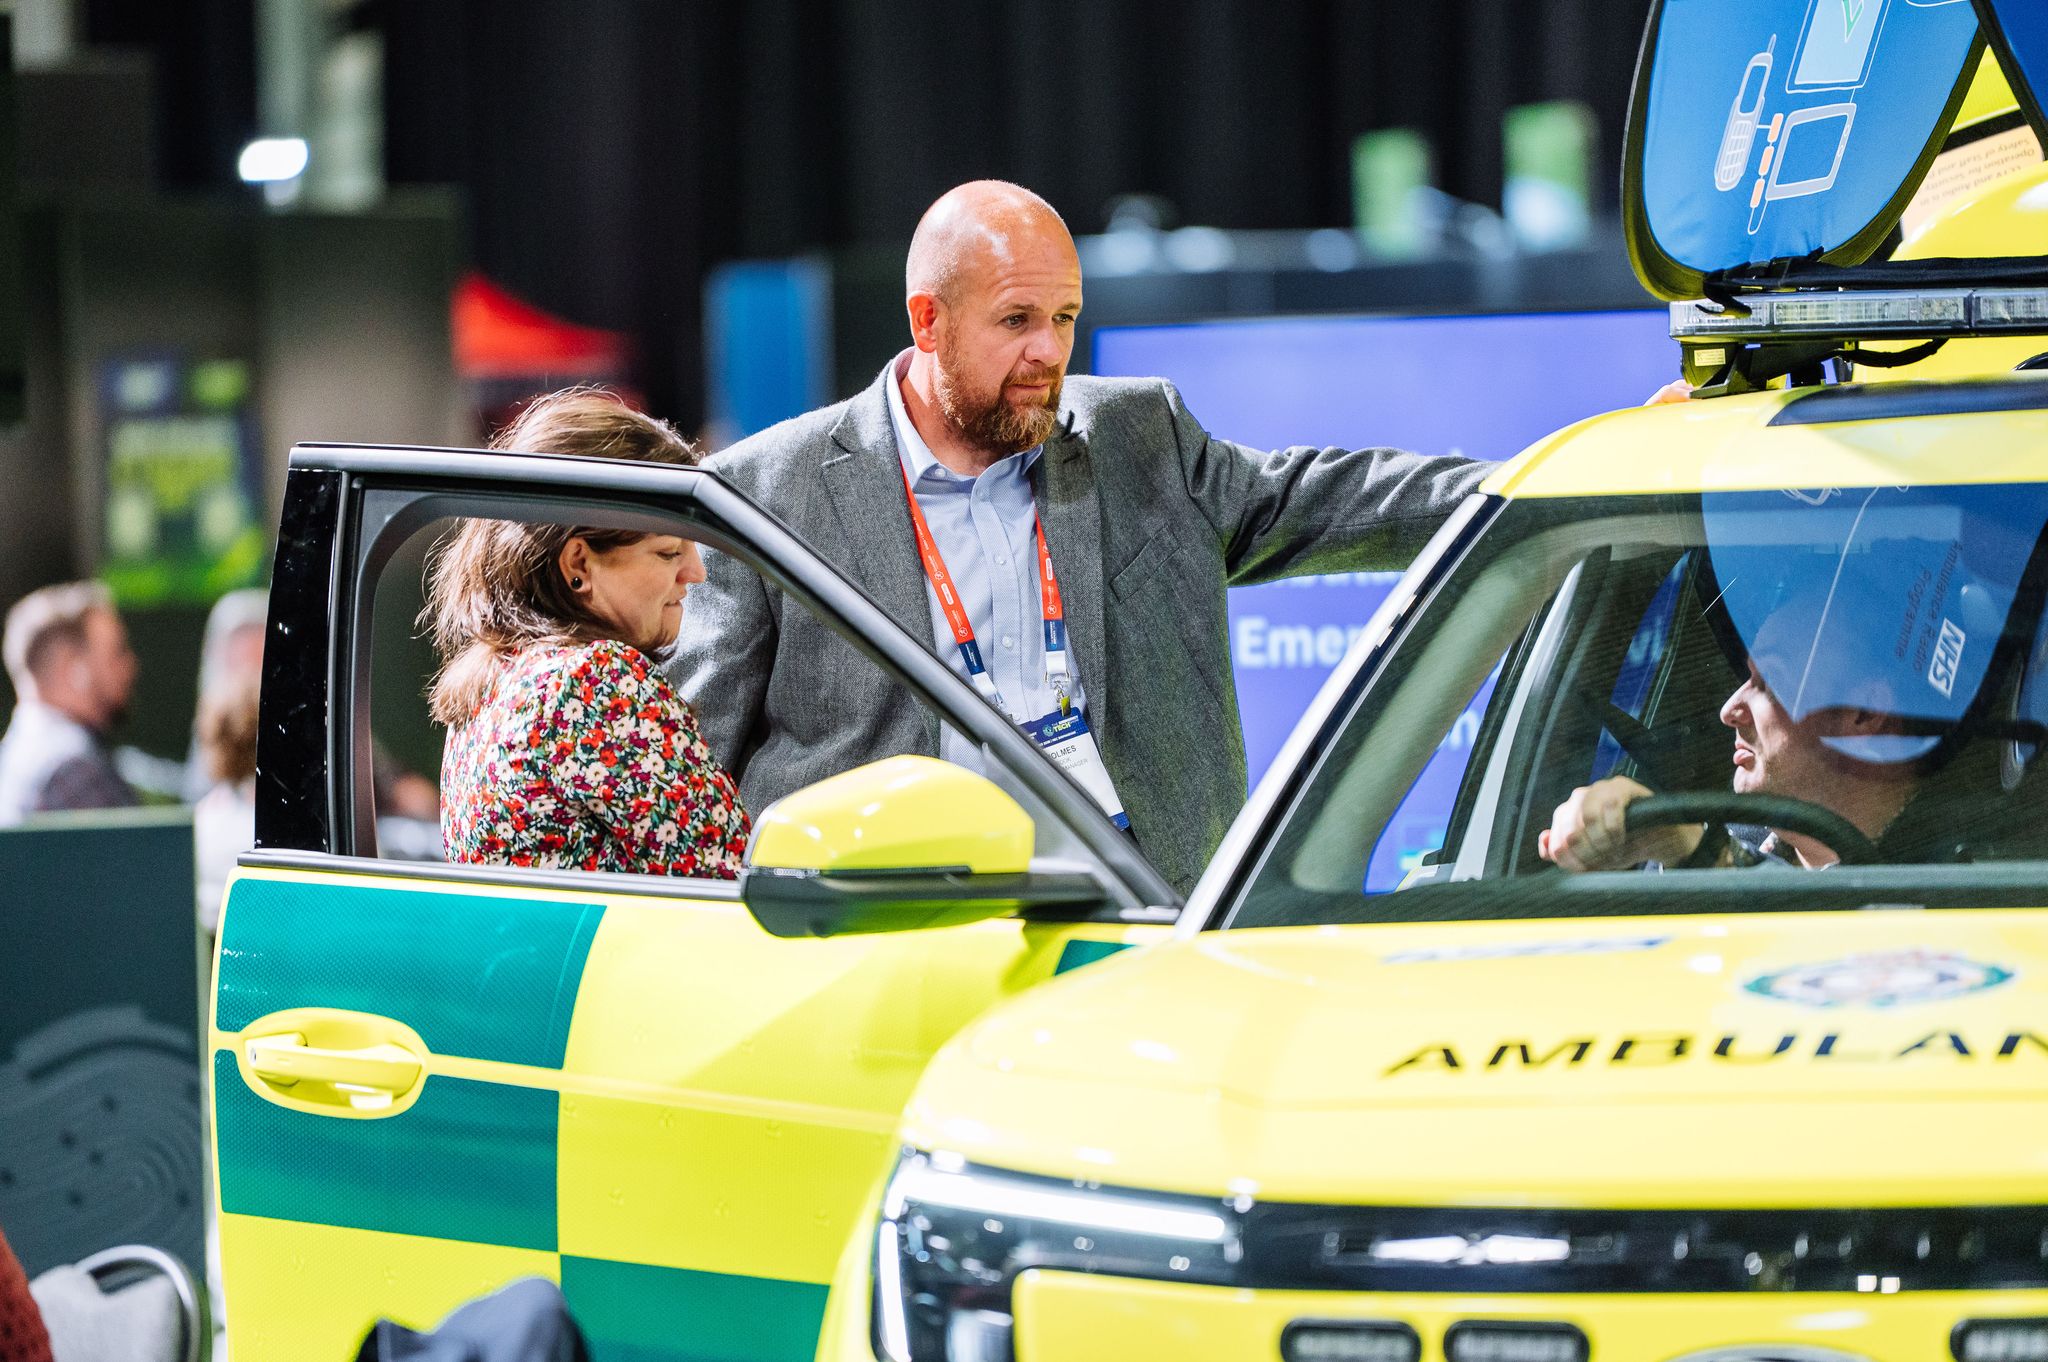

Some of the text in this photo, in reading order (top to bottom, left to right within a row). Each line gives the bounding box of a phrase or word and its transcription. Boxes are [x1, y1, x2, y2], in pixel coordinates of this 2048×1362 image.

[1998, 139, 2030, 153] Safety
[1984, 148, 2035, 170] Operation
[1895, 569, 1931, 659] Programme
[1931, 620, 1964, 692] NHS
[1049, 745, 1077, 760] OLMES
